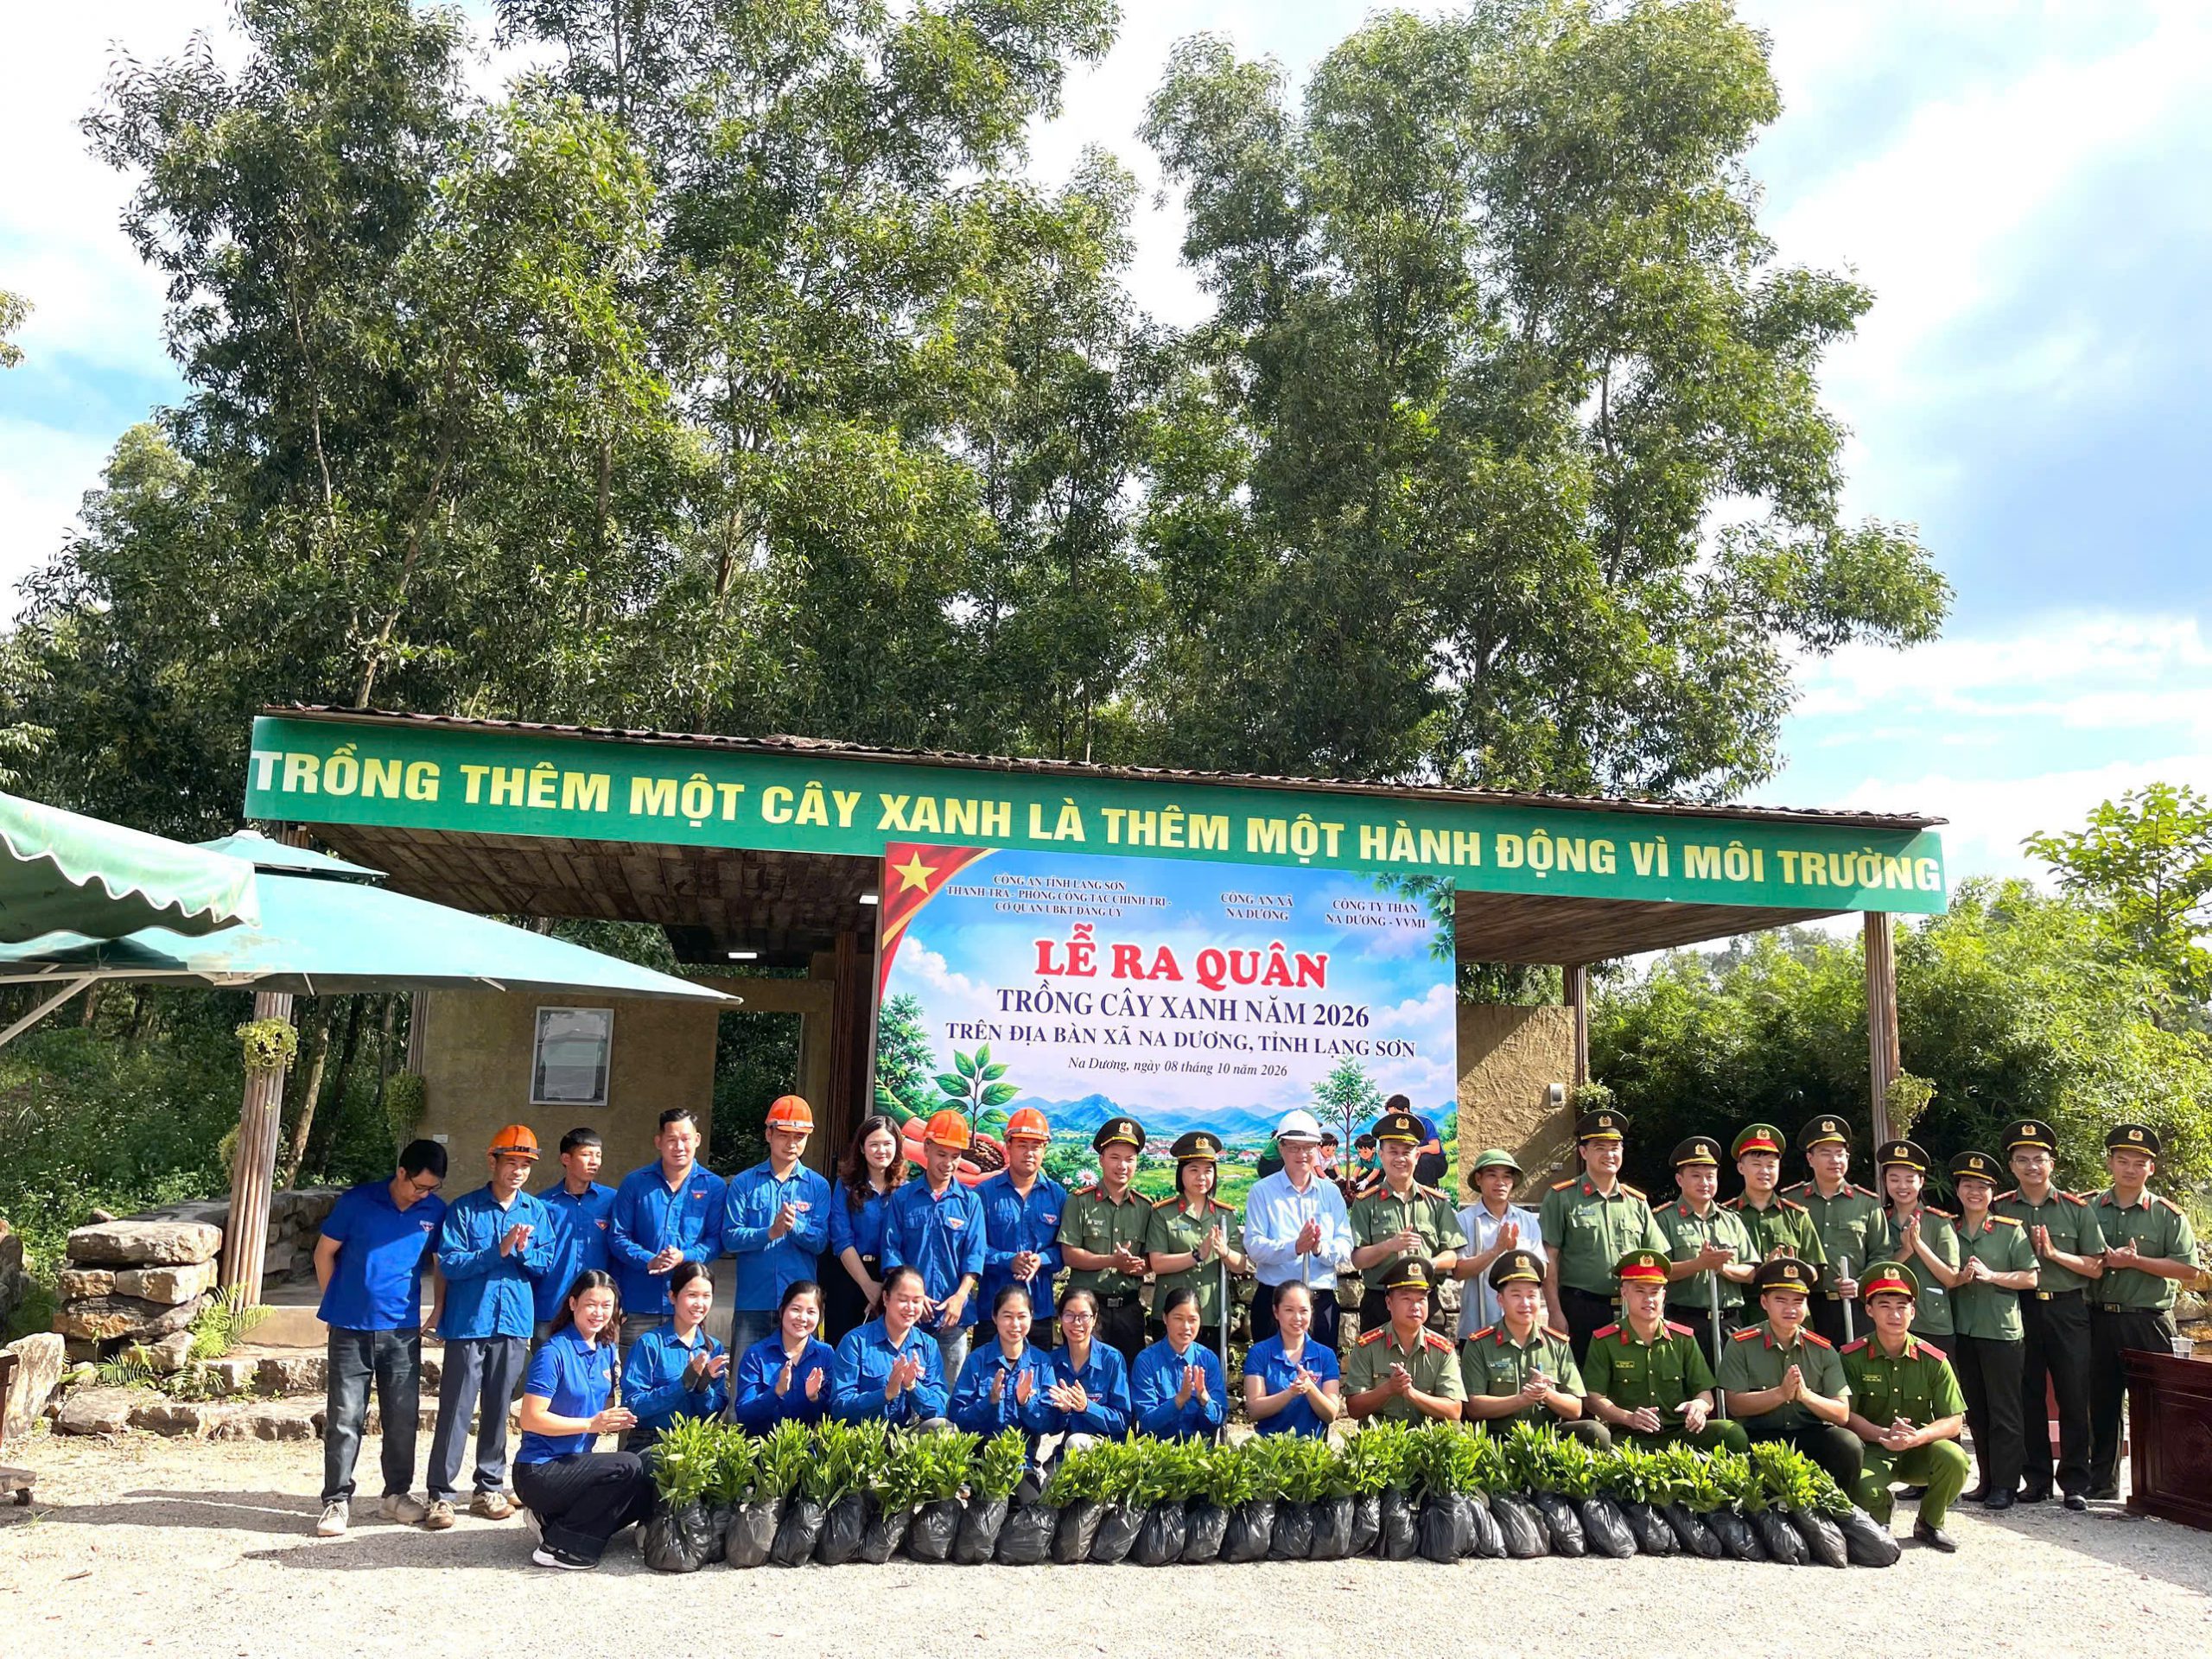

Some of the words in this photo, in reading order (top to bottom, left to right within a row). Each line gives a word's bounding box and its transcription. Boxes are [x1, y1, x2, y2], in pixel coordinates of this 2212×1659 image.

[251, 743, 441, 802] TRỒNG
[460, 761, 611, 812] THÊM
[629, 772, 745, 828] MỘT
[761, 780, 861, 828] CÂY
[877, 793, 1012, 837] XANH
[1028, 798, 1086, 842] LÀ
[1101, 804, 1230, 851] THÊM
[1246, 813, 1344, 864] MỘT
[1359, 820, 1481, 867] HÀNH
[1495, 828, 1616, 878] ĐỘNG
[1630, 836, 1669, 877] VÌ
[1684, 840, 1764, 882] MÔI
[1777, 847, 1942, 892] TRƯỜNG
[994, 874, 1024, 885] CÔNG
[1027, 877, 1042, 887] AN
[1104, 880, 1125, 891] SƠN
[947, 886, 985, 896] THANH
[988, 888, 1009, 898] TRA
[1019, 889, 1056, 901] PHÒNG
[1058, 891, 1088, 903] CÔNG
[1090, 893, 1111, 904] TÁC
[1112, 893, 1146, 906] CHÍNH
[1221, 892, 1254, 905] CÔNG
[1258, 896, 1274, 906] AN
[1277, 894, 1294, 907] XÃ
[1013, 903, 1043, 914] QUAN
[1046, 905, 1074, 915] UBKT
[1227, 908, 1243, 918] NA
[1246, 909, 1289, 921] DƯƠNG
[1332, 898, 1366, 912] CÔNG
[1369, 902, 1382, 912] TY
[1387, 903, 1418, 914] THAN
[1326, 914, 1343, 925] NA
[1345, 914, 1386, 927] DƯƠNG
[1395, 918, 1426, 929] VVMI
[1035, 923, 1097, 978] LỄ
[1111, 944, 1184, 982] RA
[1196, 942, 1326, 993] QUÂN
[996, 979, 1093, 1015] TRỒNG
[1100, 987, 1154, 1017] CÂY
[1160, 995, 1237, 1021] XANH
[1245, 995, 1306, 1025] NĂM
[1313, 1003, 1370, 1027] 2026
[945, 1019, 1002, 1040] TRÊN
[1009, 1025, 1046, 1046] ĐỊA
[1054, 1022, 1096, 1044] BÀN
[1103, 1025, 1132, 1046] XÃ
[1139, 1030, 1167, 1047] NA
[1174, 1030, 1254, 1053] DƯƠNG,
[1258, 1031, 1308, 1053] TỈNH
[1314, 1038, 1370, 1058] LẠNG
[1376, 1039, 1415, 1058] SƠN
[1068, 1057, 1085, 1069] Na
[1089, 1058, 1129, 1072] Dương,
[1134, 1059, 1160, 1074] ngày
[1164, 1060, 1179, 1072] 08
[1181, 1061, 1213, 1075] tháng
[1217, 1063, 1230, 1074] 10
[1233, 1063, 1257, 1075] năm
[1261, 1065, 1287, 1077] 2026
